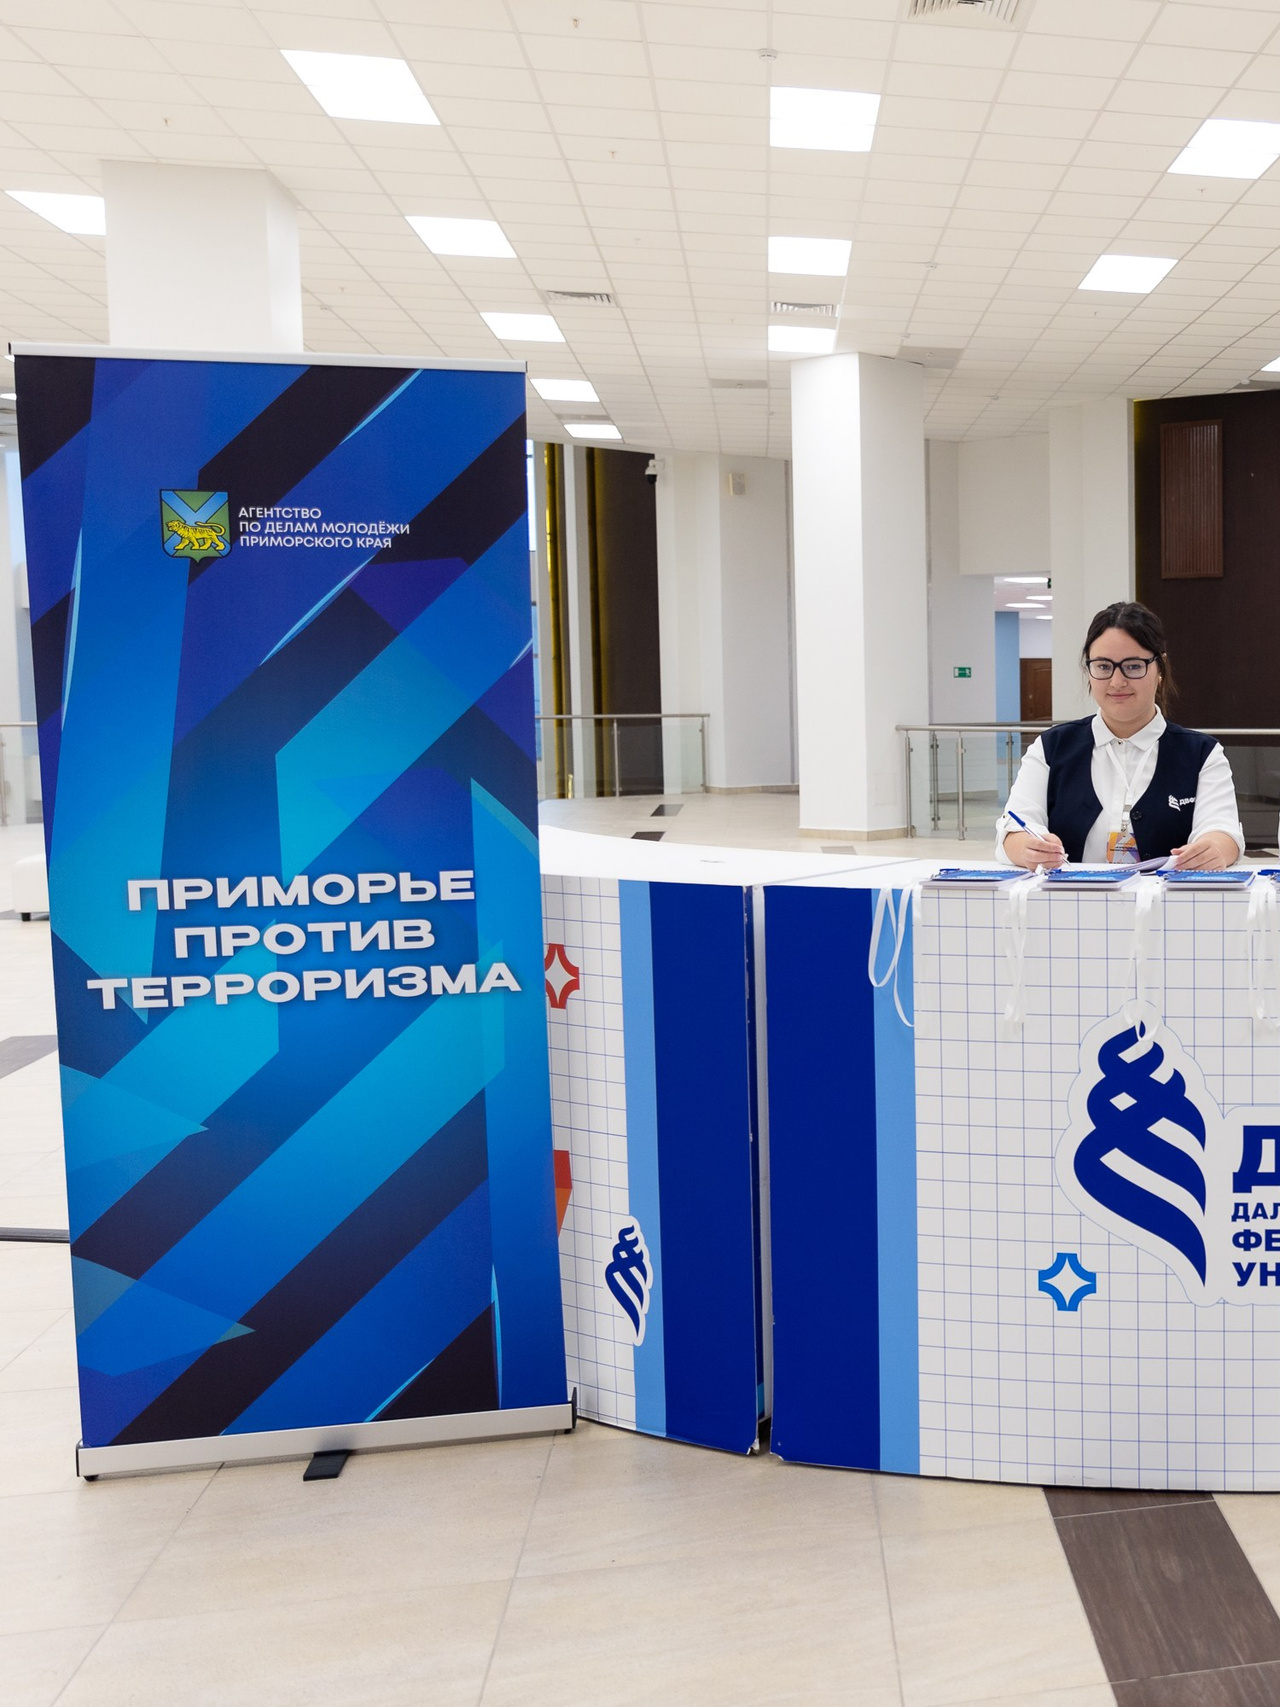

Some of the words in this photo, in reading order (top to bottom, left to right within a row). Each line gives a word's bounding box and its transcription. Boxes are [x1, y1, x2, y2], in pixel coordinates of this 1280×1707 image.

[238, 506, 322, 519] АГЕНТСТВО
[239, 521, 261, 533] ПО
[264, 522, 320, 534] ДЕЛАМ
[322, 521, 410, 535] МОЛОДЁЖИ
[240, 536, 353, 548] ПРИМОРСКОГО
[356, 537, 392, 549] КРАЯ
[127, 870, 475, 911] ПРИМОРЬЕ
[174, 919, 435, 958] ПРОТИВ
[87, 962, 522, 1010] ТЕРРОРИЗМА
